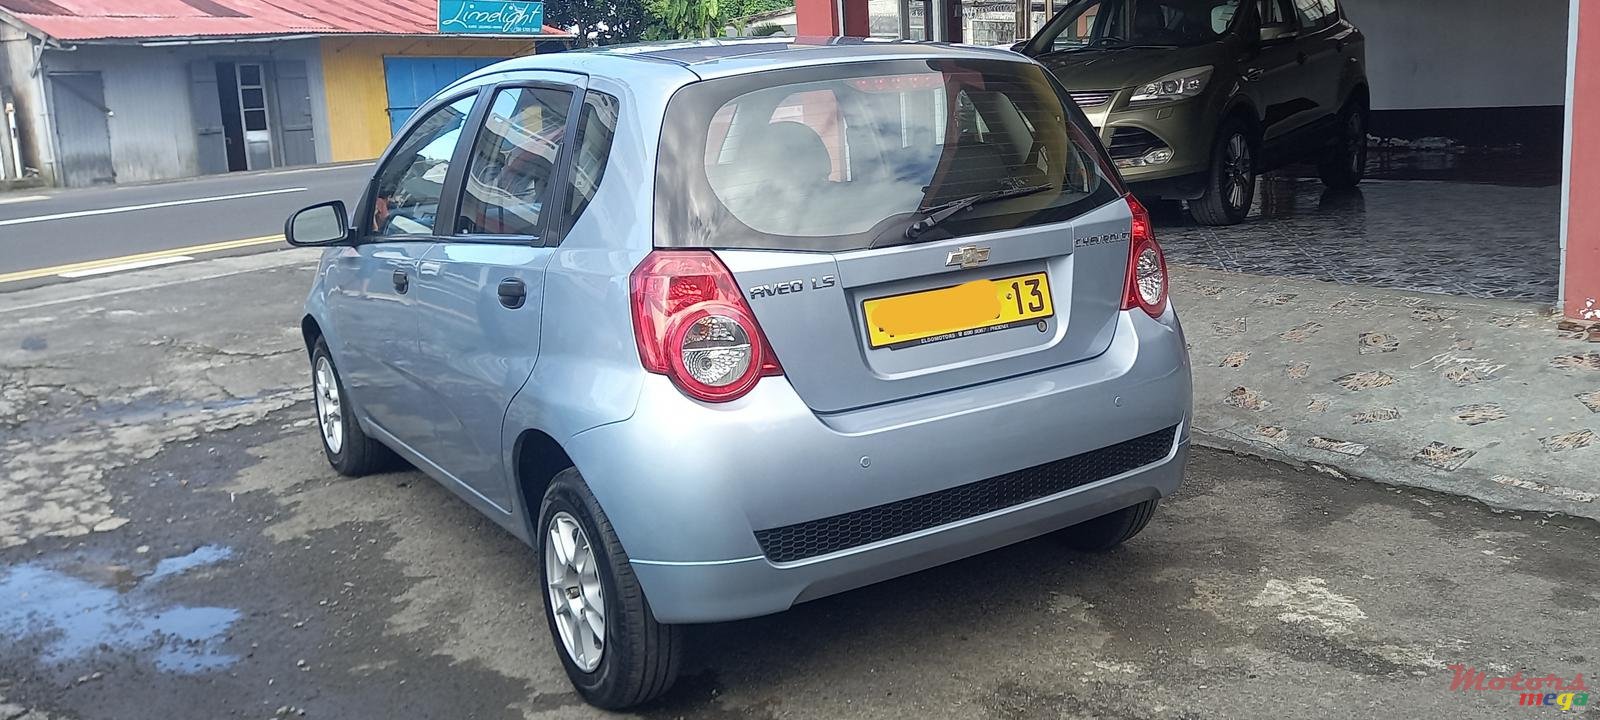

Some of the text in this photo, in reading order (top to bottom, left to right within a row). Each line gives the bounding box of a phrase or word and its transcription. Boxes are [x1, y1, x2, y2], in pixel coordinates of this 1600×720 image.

[442, 2, 541, 32] Limelight
[749, 274, 836, 300] AVEO LS
[1011, 278, 1045, 315] 13
